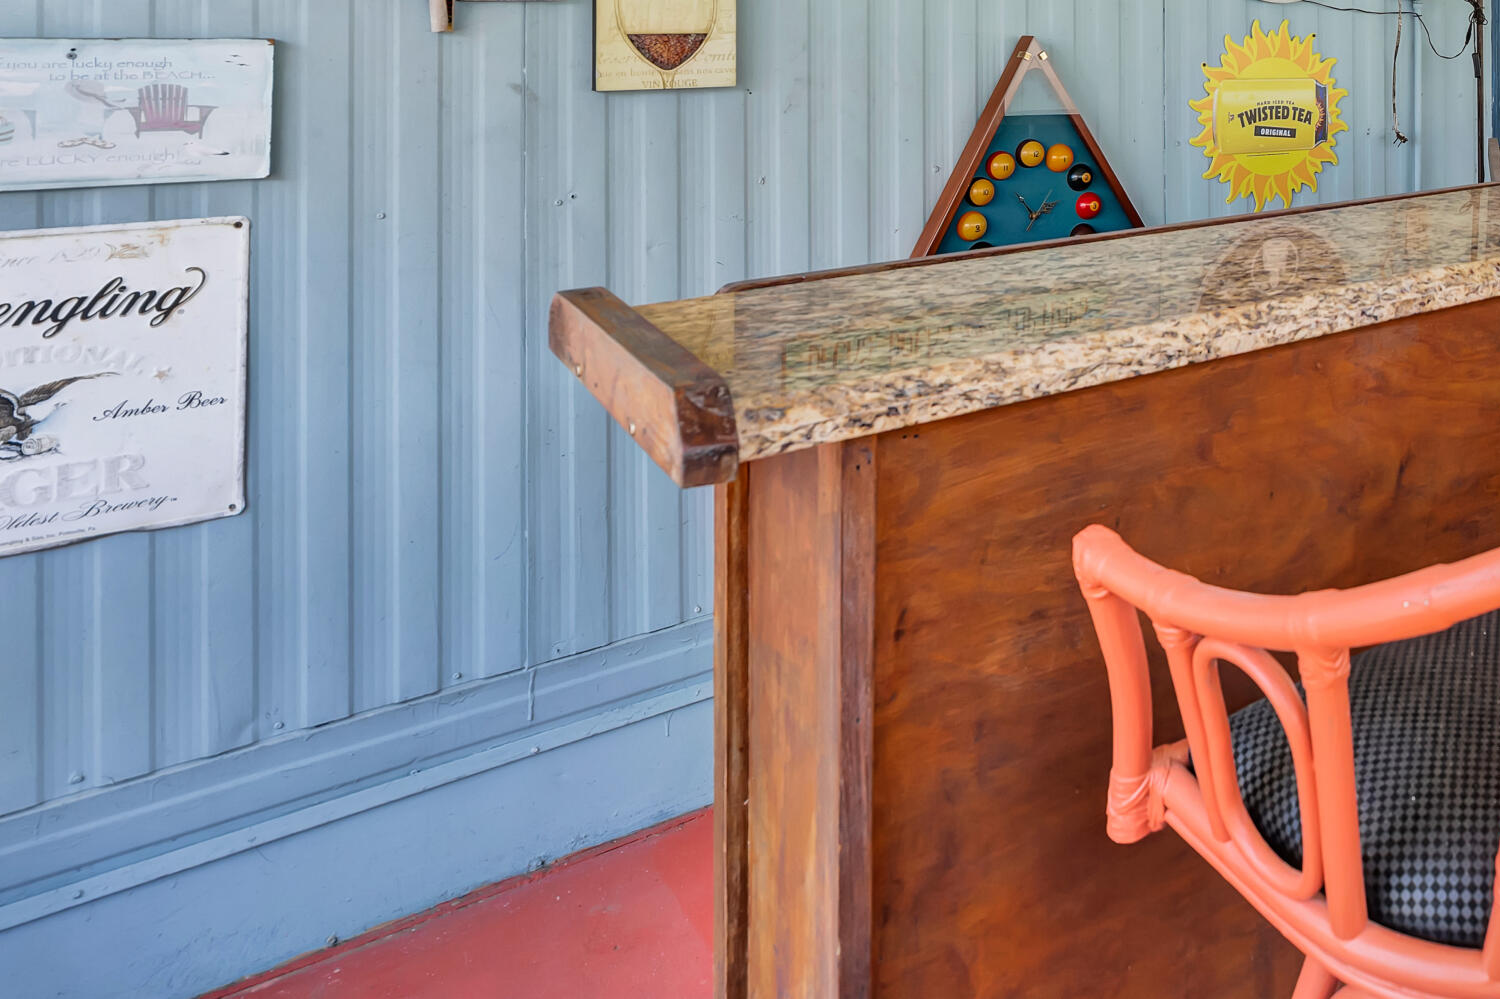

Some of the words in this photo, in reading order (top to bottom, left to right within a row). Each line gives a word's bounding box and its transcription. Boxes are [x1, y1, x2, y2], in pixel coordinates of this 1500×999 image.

[42, 61, 67, 70] are
[71, 57, 112, 72] lucky
[117, 56, 173, 71] enough
[49, 71, 66, 81] to
[70, 69, 90, 81] be
[93, 70, 109, 81] at
[113, 68, 139, 81] the
[1237, 105, 1290, 128] TWISTED
[1292, 106, 1314, 125] TEA
[1259, 127, 1292, 137] ORIGINAL
[26, 150, 100, 167] LUCKY
[0, 267, 207, 339] engling
[93, 400, 169, 422] Amber
[176, 390, 228, 411] Beer
[0, 453, 151, 508] GER
